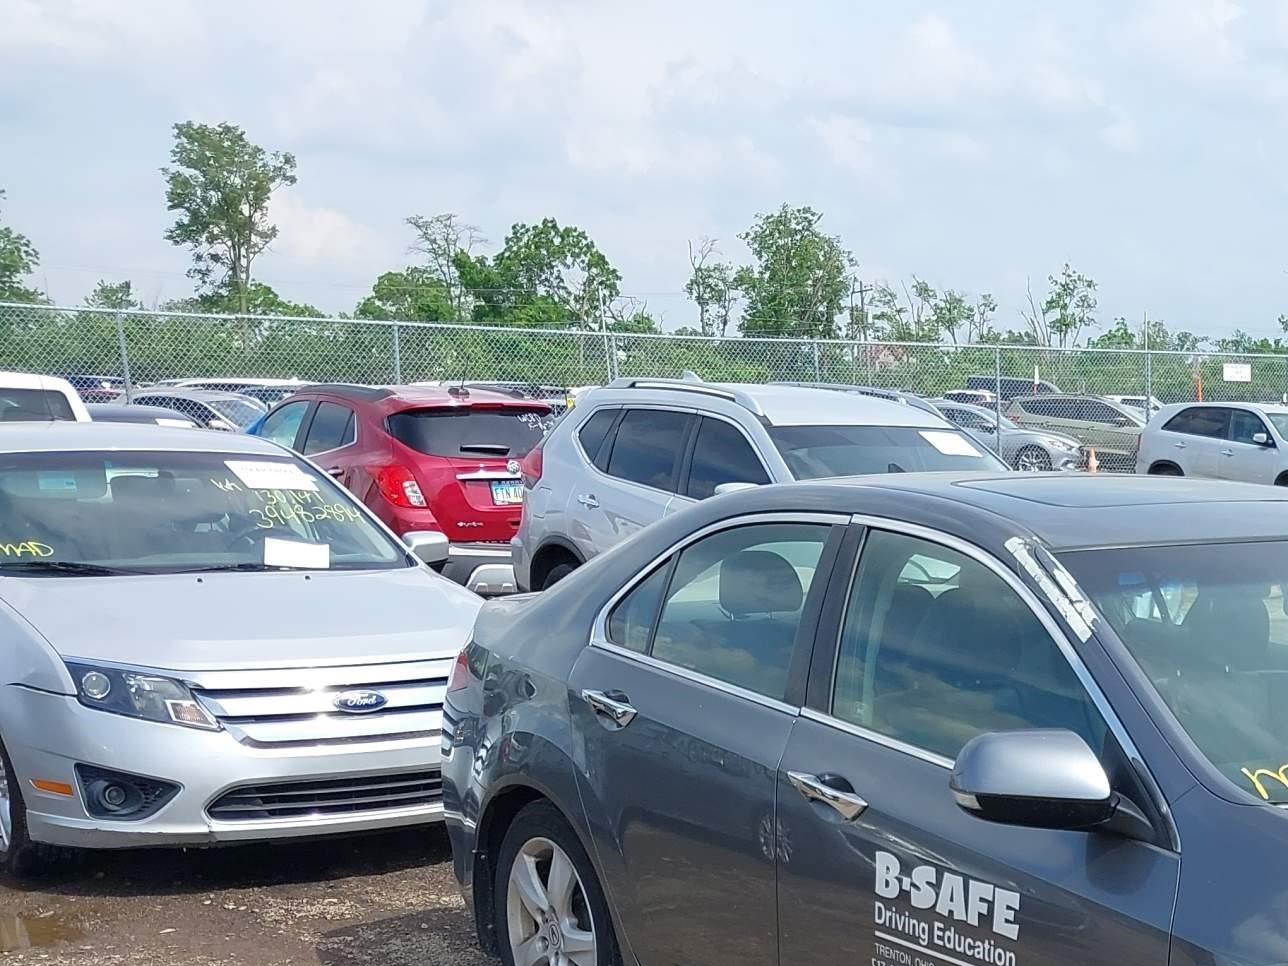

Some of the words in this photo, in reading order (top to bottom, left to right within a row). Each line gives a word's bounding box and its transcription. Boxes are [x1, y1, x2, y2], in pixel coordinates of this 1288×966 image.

[345, 692, 378, 707] Ford
[875, 850, 1021, 941] B-SAFE
[874, 901, 929, 946] Driving
